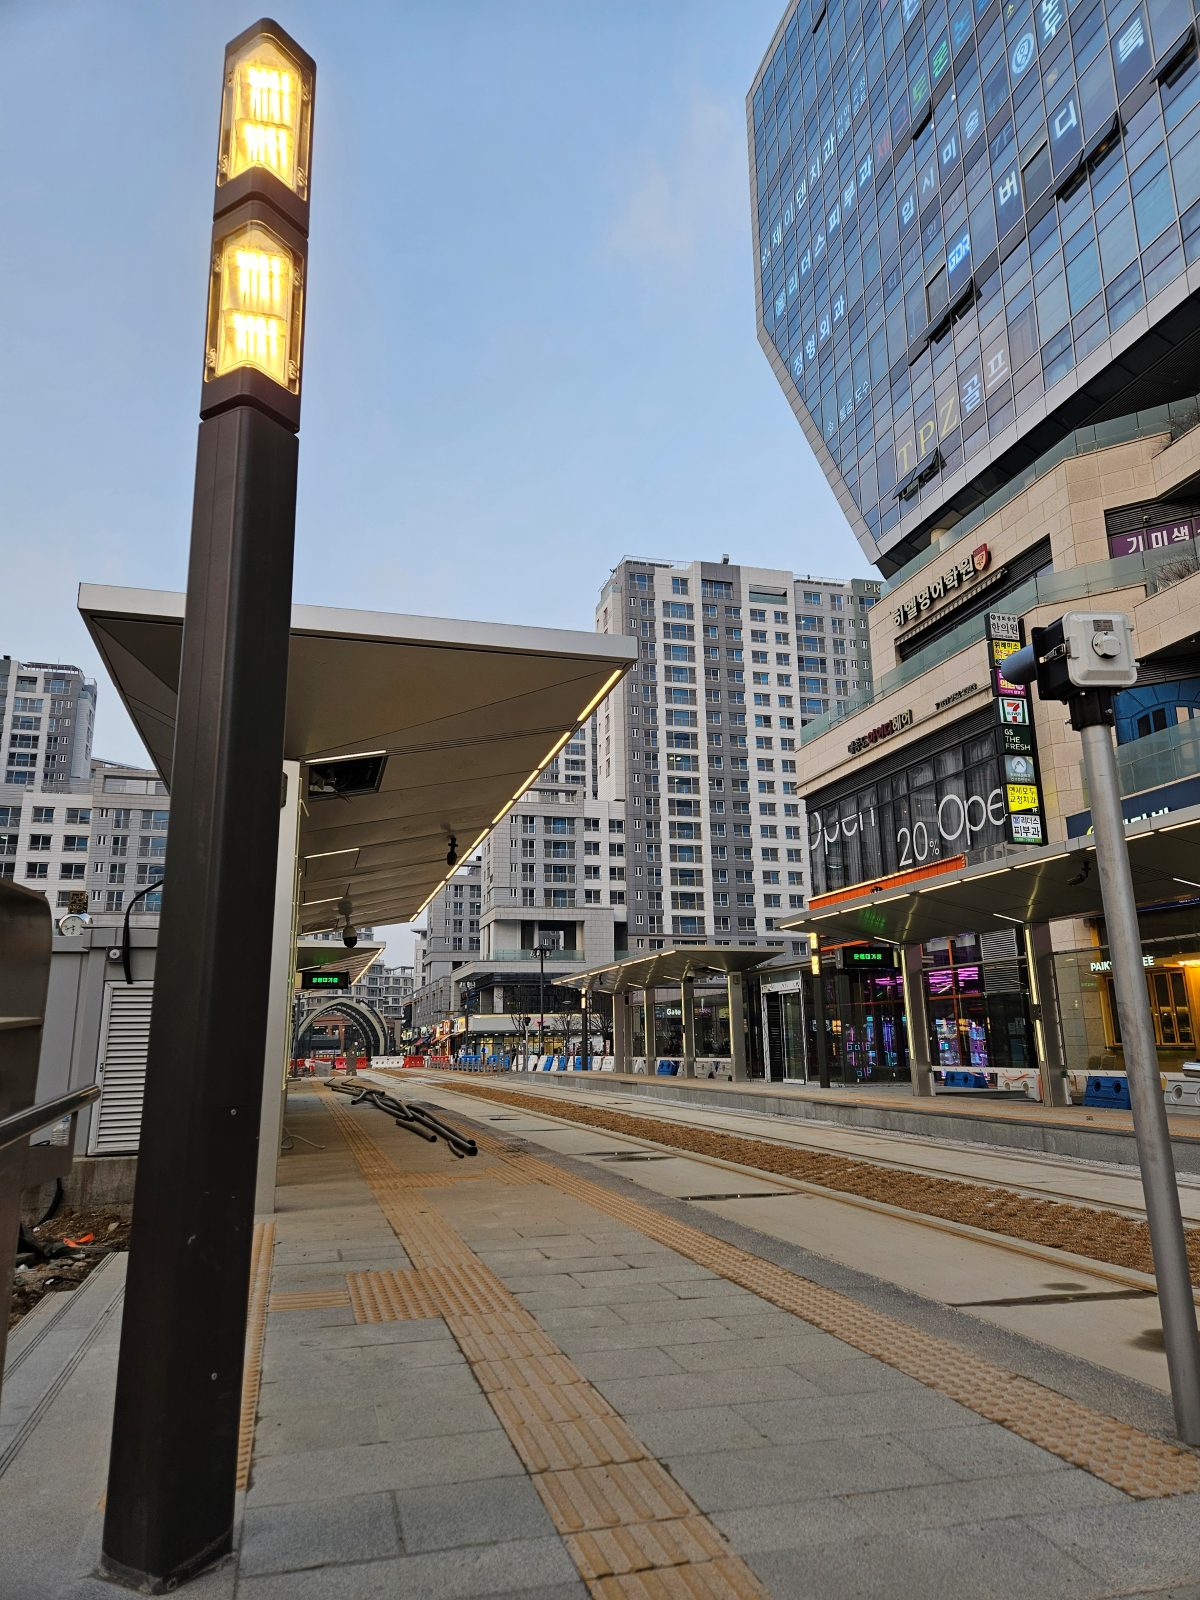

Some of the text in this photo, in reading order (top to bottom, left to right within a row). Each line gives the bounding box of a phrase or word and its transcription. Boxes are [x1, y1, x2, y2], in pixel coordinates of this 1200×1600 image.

[961, 349, 1009, 413] 골프
[992, 622, 1018, 635] 한의원
[1004, 728, 1014, 736] GS
[1005, 735, 1021, 743] THE
[1005, 743, 1031, 751] FRESH
[1009, 786, 1035, 796] 연세모두
[1010, 796, 1036, 805] 교정치과
[1020, 816, 1039, 825] 리더스
[1013, 825, 1040, 837] 피부과
